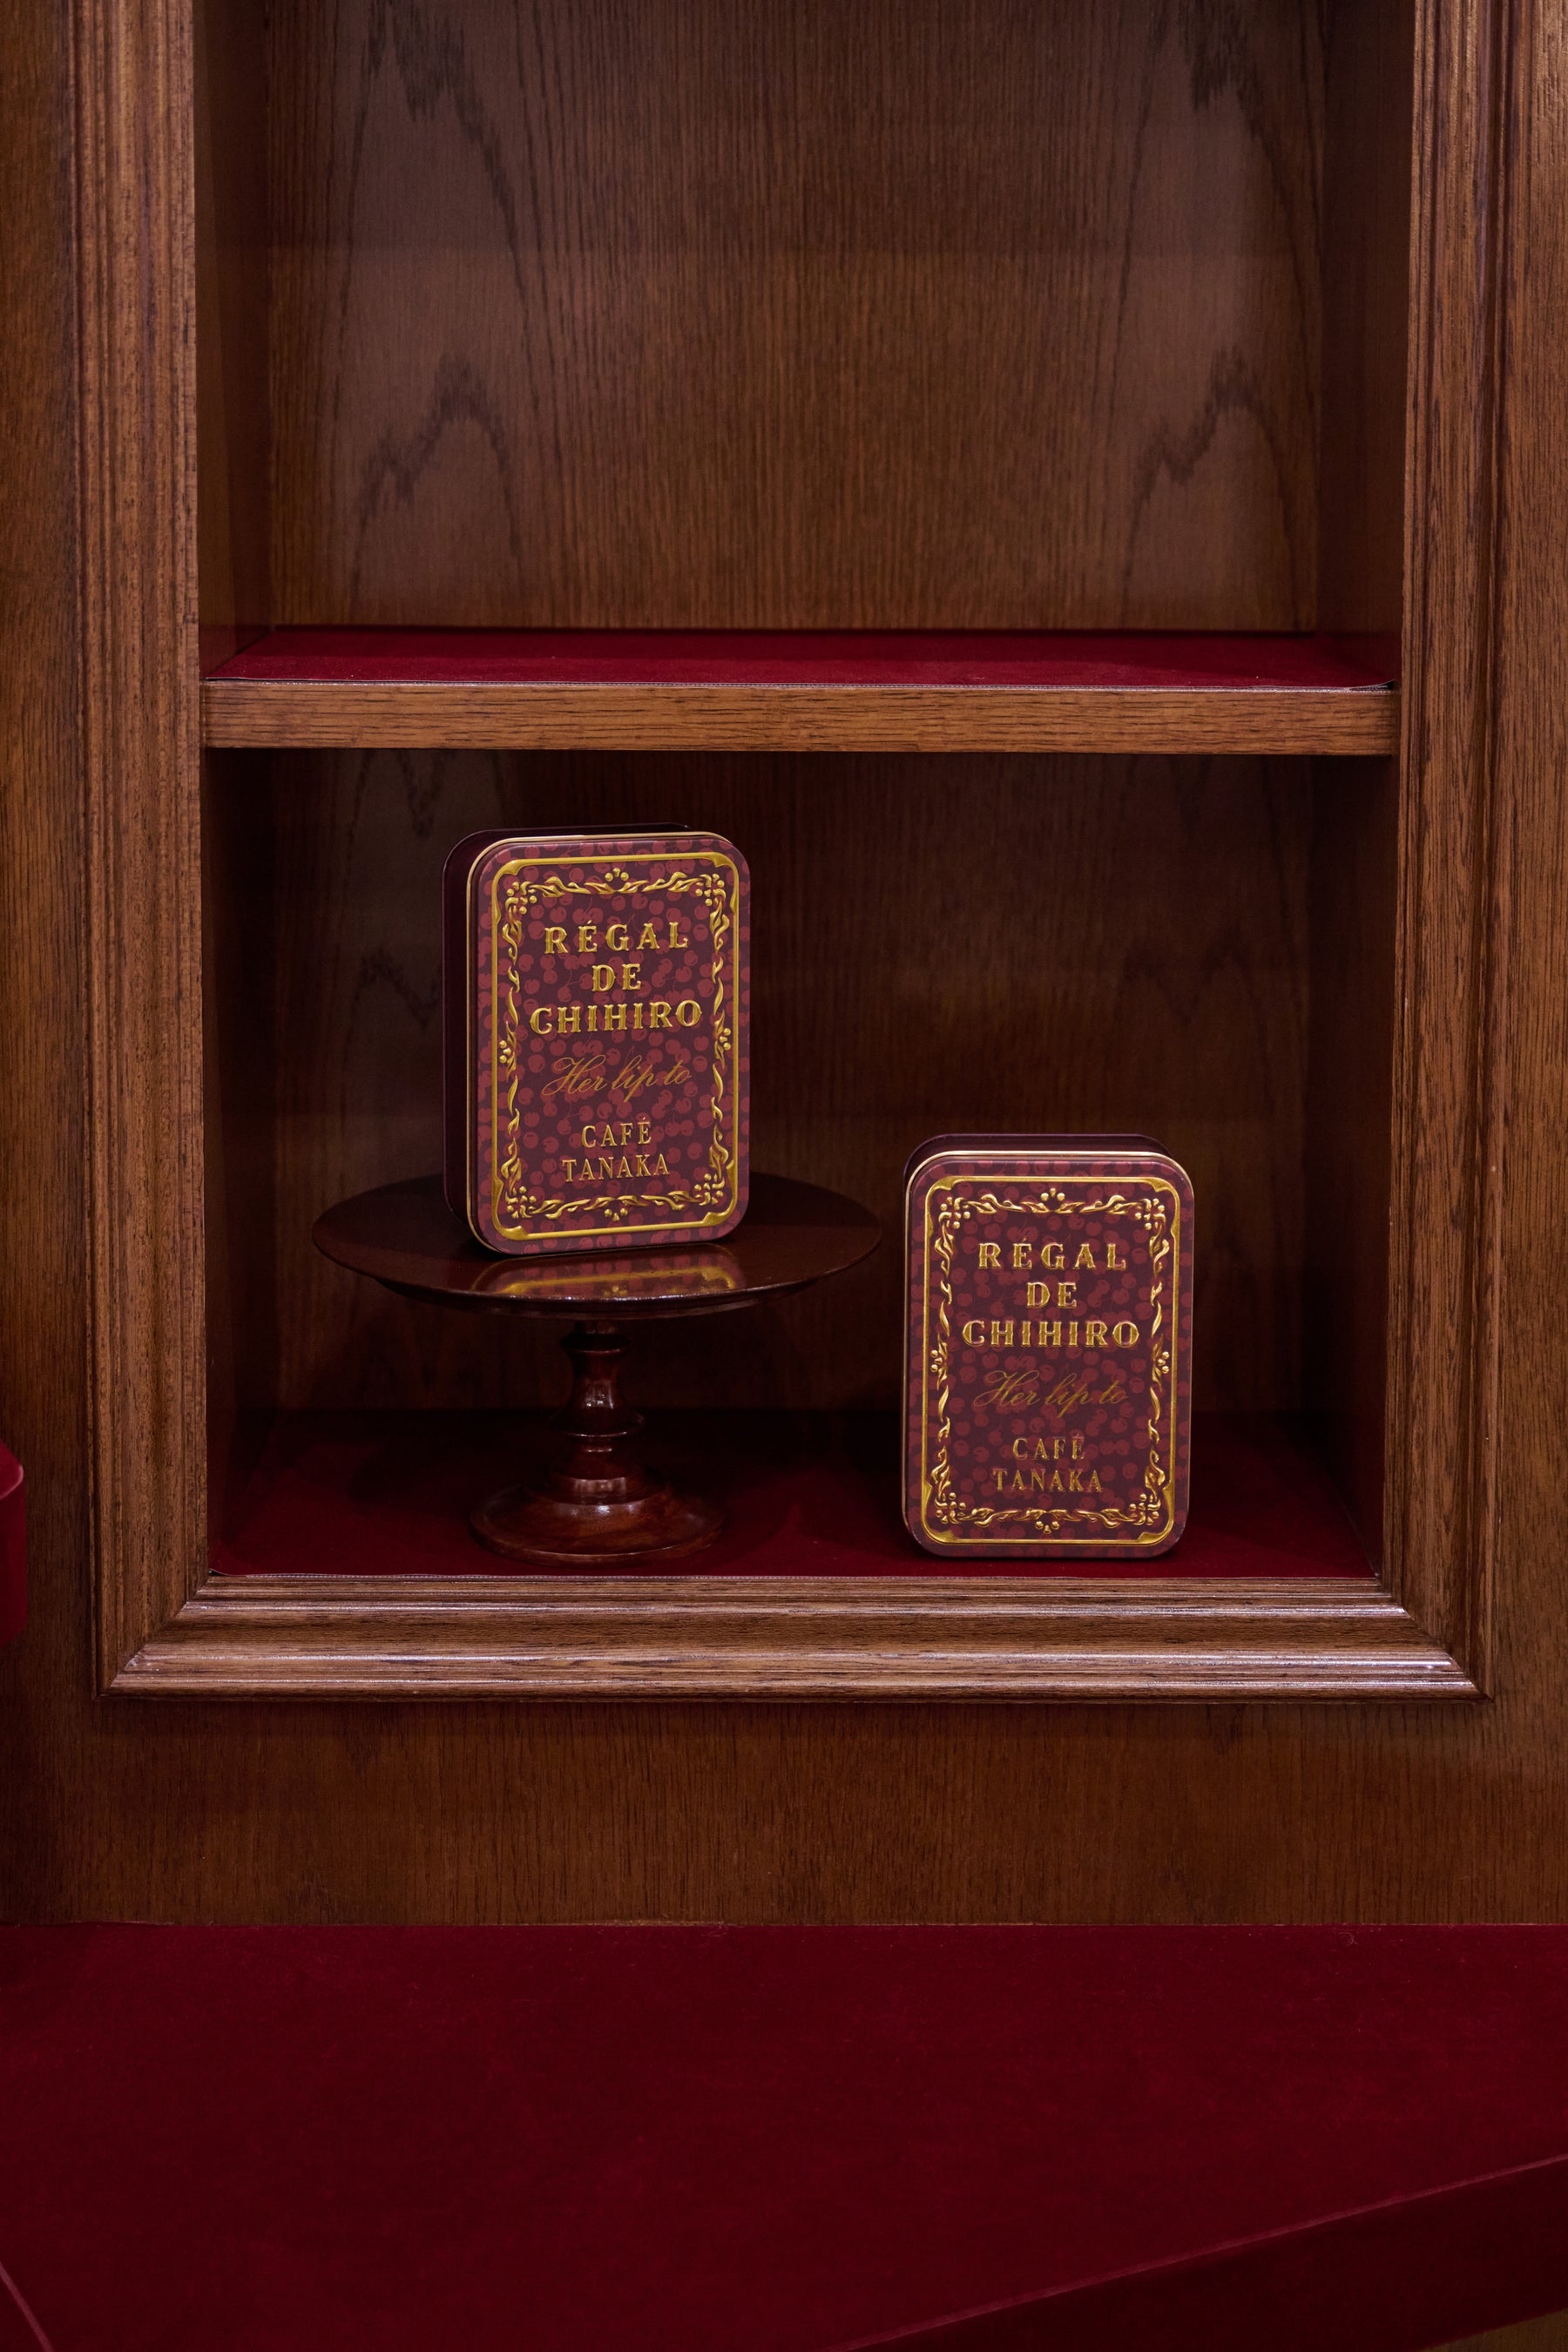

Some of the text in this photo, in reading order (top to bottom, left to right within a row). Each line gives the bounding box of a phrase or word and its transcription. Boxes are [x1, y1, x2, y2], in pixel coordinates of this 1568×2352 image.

[544, 920, 688, 954] RÉGAL
[591, 963, 642, 992] DE
[529, 1000, 702, 1034] CHIHIRO
[541, 1055, 692, 1103] Her lip to
[581, 1117, 652, 1148] CAFÉ
[562, 1152, 669, 1182] TANAKA
[977, 1238, 1126, 1270] RÉGAL
[1026, 1281, 1078, 1309] DE
[962, 1320, 1139, 1348] CHIHIRO
[973, 1369, 1128, 1418] Her lip to
[1012, 1434, 1085, 1460] CAFÉ
[992, 1468, 1104, 1492] TANAKA
